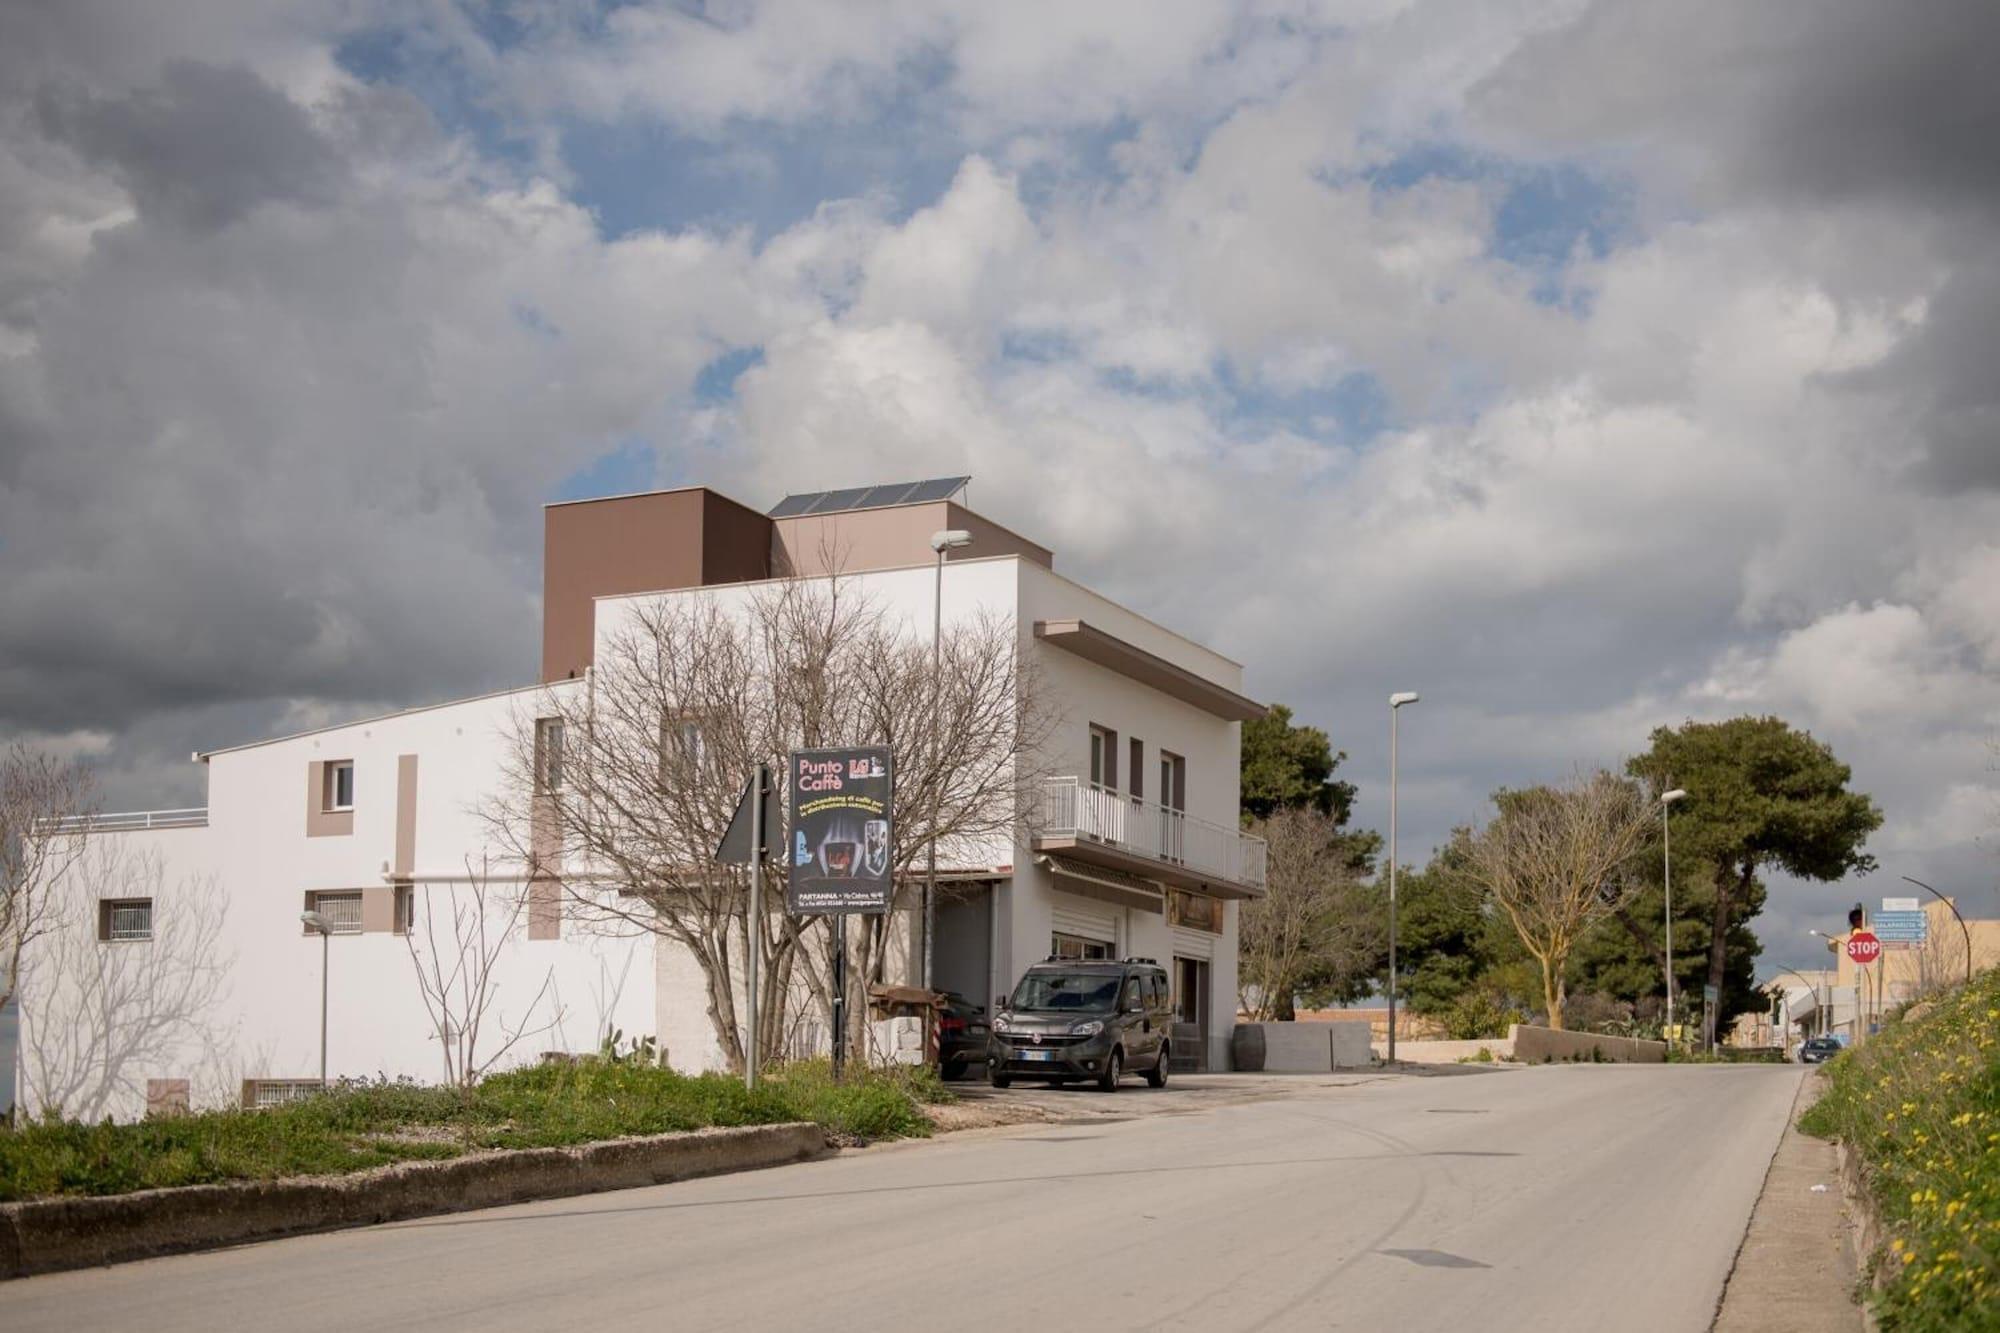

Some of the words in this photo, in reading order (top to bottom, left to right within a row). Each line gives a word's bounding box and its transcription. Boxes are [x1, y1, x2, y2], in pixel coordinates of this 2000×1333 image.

[799, 759, 843, 774] Punto
[799, 774, 843, 791] Caffè
[799, 893, 838, 901] PARTANNA
[1848, 941, 1879, 955] STOP
